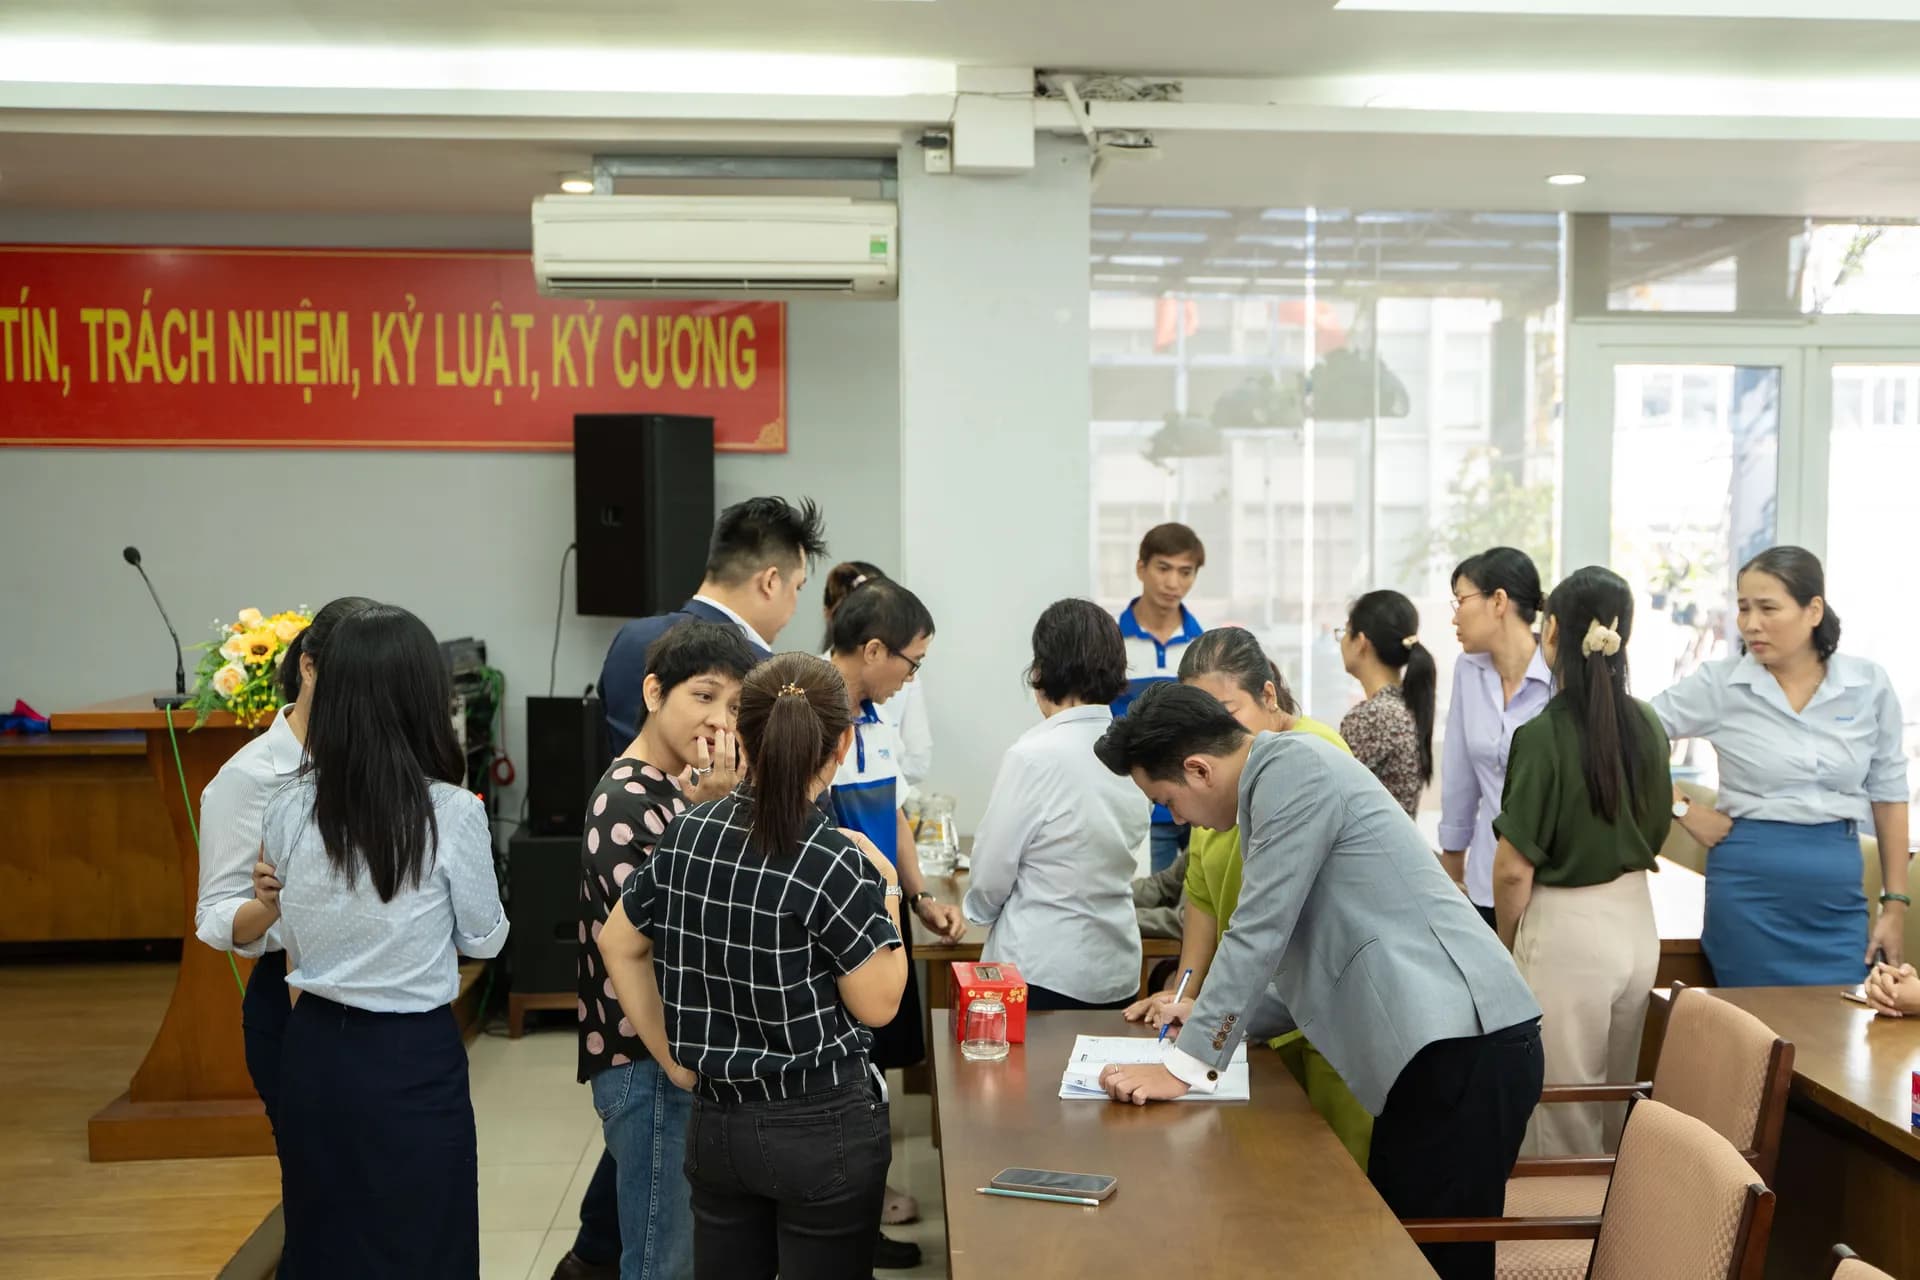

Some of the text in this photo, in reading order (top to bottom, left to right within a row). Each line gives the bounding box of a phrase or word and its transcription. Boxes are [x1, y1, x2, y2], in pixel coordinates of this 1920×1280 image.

[0, 286, 757, 406] TÍN, TRÁCH NHIỆM, KỶ LUẬT, KỶ CƯƠNG
